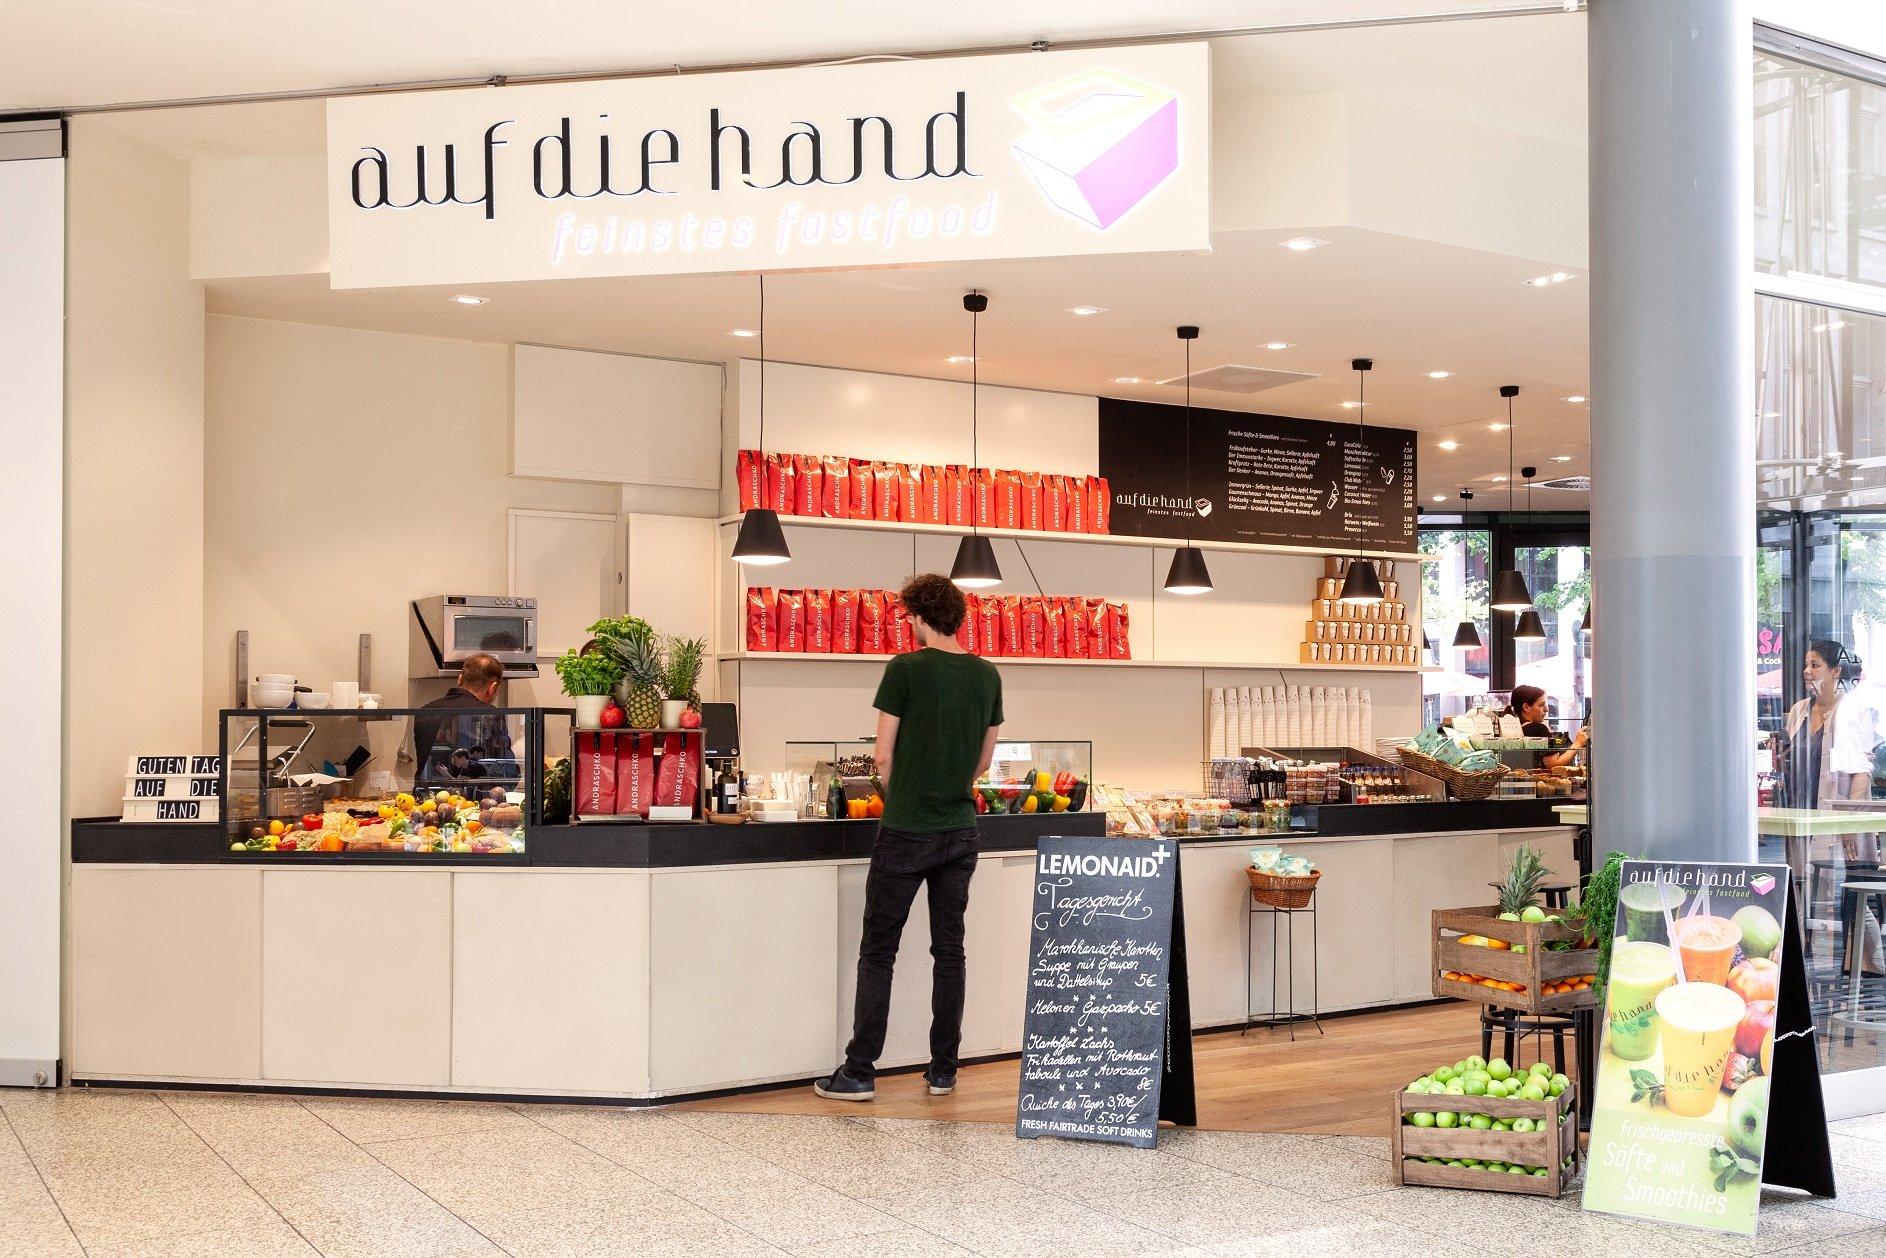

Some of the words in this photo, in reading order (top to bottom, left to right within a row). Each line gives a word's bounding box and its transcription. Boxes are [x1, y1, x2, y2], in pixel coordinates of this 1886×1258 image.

[555, 214, 752, 262] feinstes
[778, 194, 997, 243] fastfood
[138, 758, 185, 774] GUTEN
[193, 757, 220, 774] TAG
[135, 780, 164, 797] AUF
[191, 780, 218, 796] DIE
[592, 752, 601, 810] ANDRASCHKO
[631, 753, 639, 810] ANDRASCHKO
[158, 802, 198, 819] HAND
[1037, 877, 1146, 927] Tagesgericht
[1715, 888, 1751, 898] fastfood
[1032, 958, 1072, 976] Suppe
[1076, 957, 1096, 970] mit
[1096, 957, 1139, 981] Graupen
[1034, 977, 1055, 988] und
[1031, 999, 1076, 1015] Melonen
[1077, 1000, 1140, 1027] Gazpacho
[1027, 1033, 1079, 1057] Kartoffel
[1079, 1036, 1115, 1049] Lachs
[1026, 1053, 1082, 1068] Frikadellen
[1086, 1051, 1103, 1063] mit
[1066, 1067, 1091, 1078] und
[1094, 1063, 1152, 1077] Avocado
[1021, 1093, 1059, 1112] Quiche
[1061, 1098, 1077, 1110] des
[1078, 1094, 1105, 1120] Tages
[1021, 1119, 1048, 1130] FRESH
[1049, 1121, 1096, 1134] FAIRTRADE
[1096, 1125, 1120, 1136] SOFT
[1120, 1127, 1153, 1139] DRINKS
[1620, 1119, 1725, 1148] Frischgepresste
[1603, 1141, 1656, 1174] Säfte
[1659, 1157, 1686, 1176] und
[1623, 1176, 1728, 1215] Smoothies
